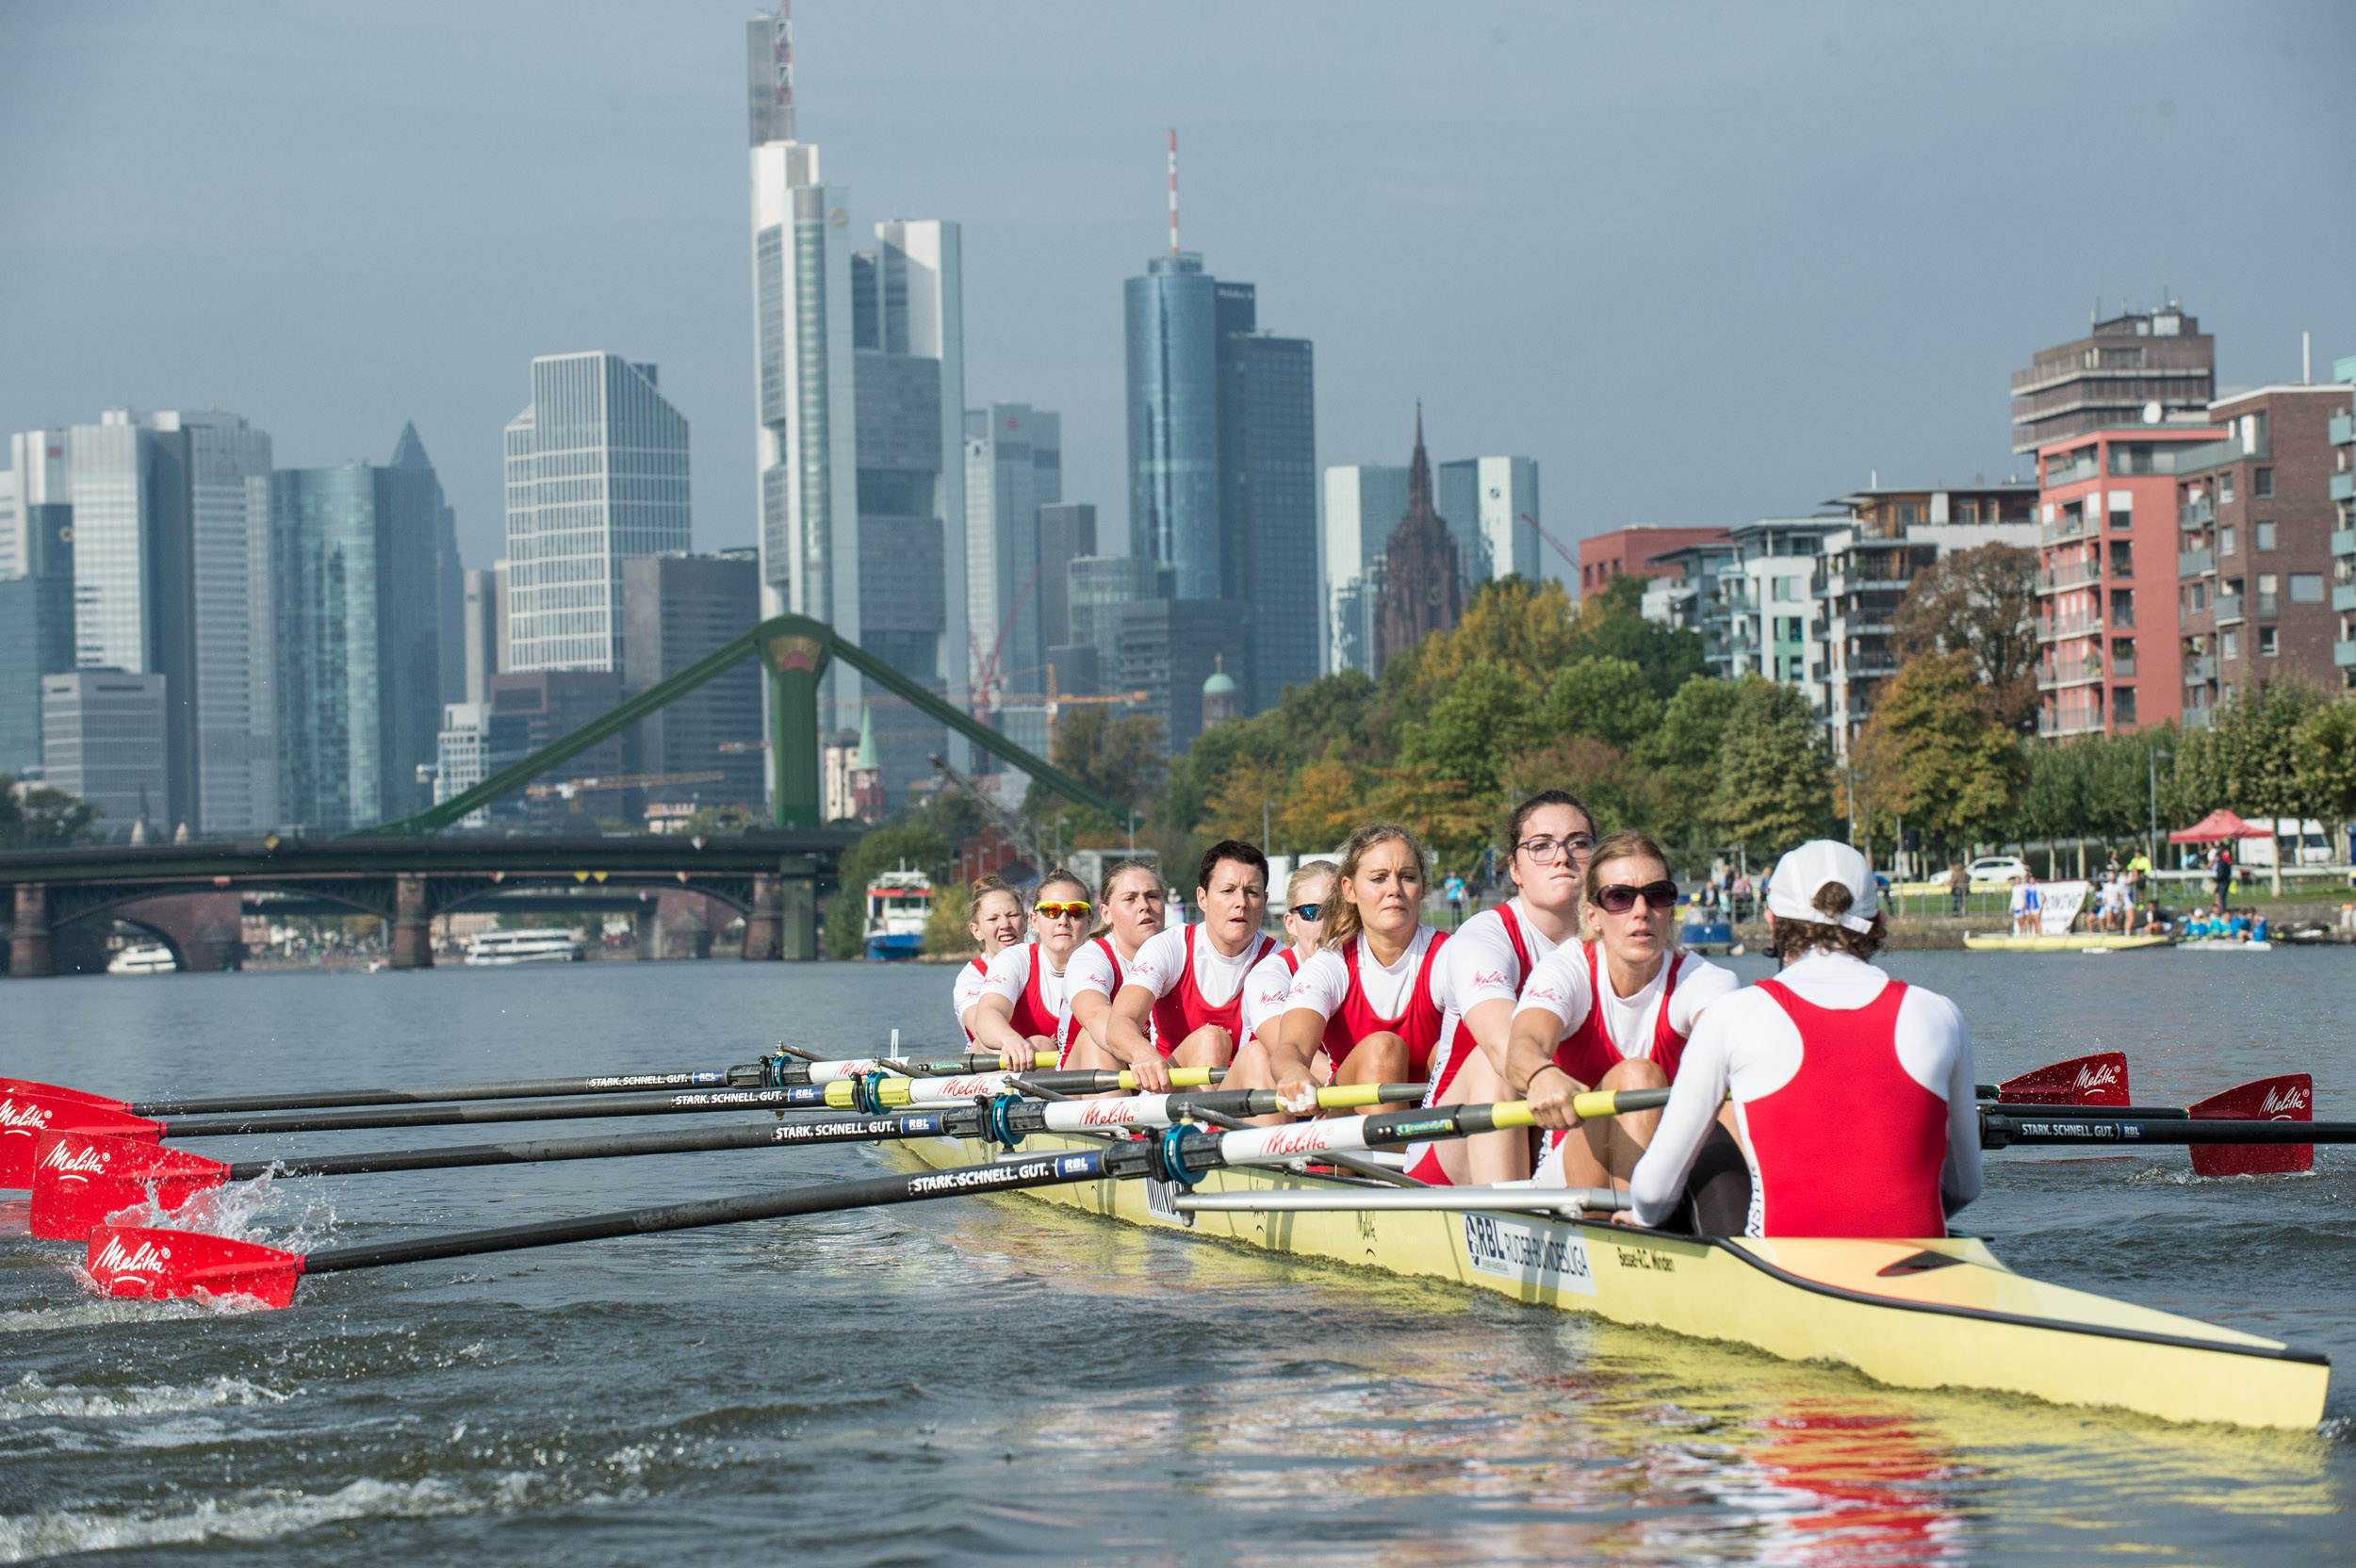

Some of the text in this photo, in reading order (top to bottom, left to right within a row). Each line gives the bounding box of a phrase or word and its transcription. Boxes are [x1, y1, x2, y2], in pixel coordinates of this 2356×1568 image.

[590, 1076, 621, 1087] STARK.
[623, 1075, 665, 1086] SCHNELL.
[666, 1073, 688, 1083] GUT.
[937, 1075, 993, 1098] Melitta
[2071, 1063, 2118, 1088] Melitta
[676, 1094, 710, 1105] STARK.
[712, 1092, 758, 1103] SCHNELL.
[760, 1090, 783, 1102] GUT.
[2258, 1085, 2306, 1117] Melitta
[1079, 1101, 1138, 1127] Melitta
[776, 1119, 929, 1140] STARK. SCHNELL. GUT. RBL
[1259, 1121, 1332, 1158] Melitta
[2021, 1123, 2140, 1137] STARK. SCHNELL. GUT. RBL
[40, 1139, 106, 1174] Melitta
[914, 1157, 1088, 1192] STARK. SCHNELL. GUT. RBL
[1477, 1217, 1506, 1261] RBL
[91, 1235, 166, 1273] Melitta
